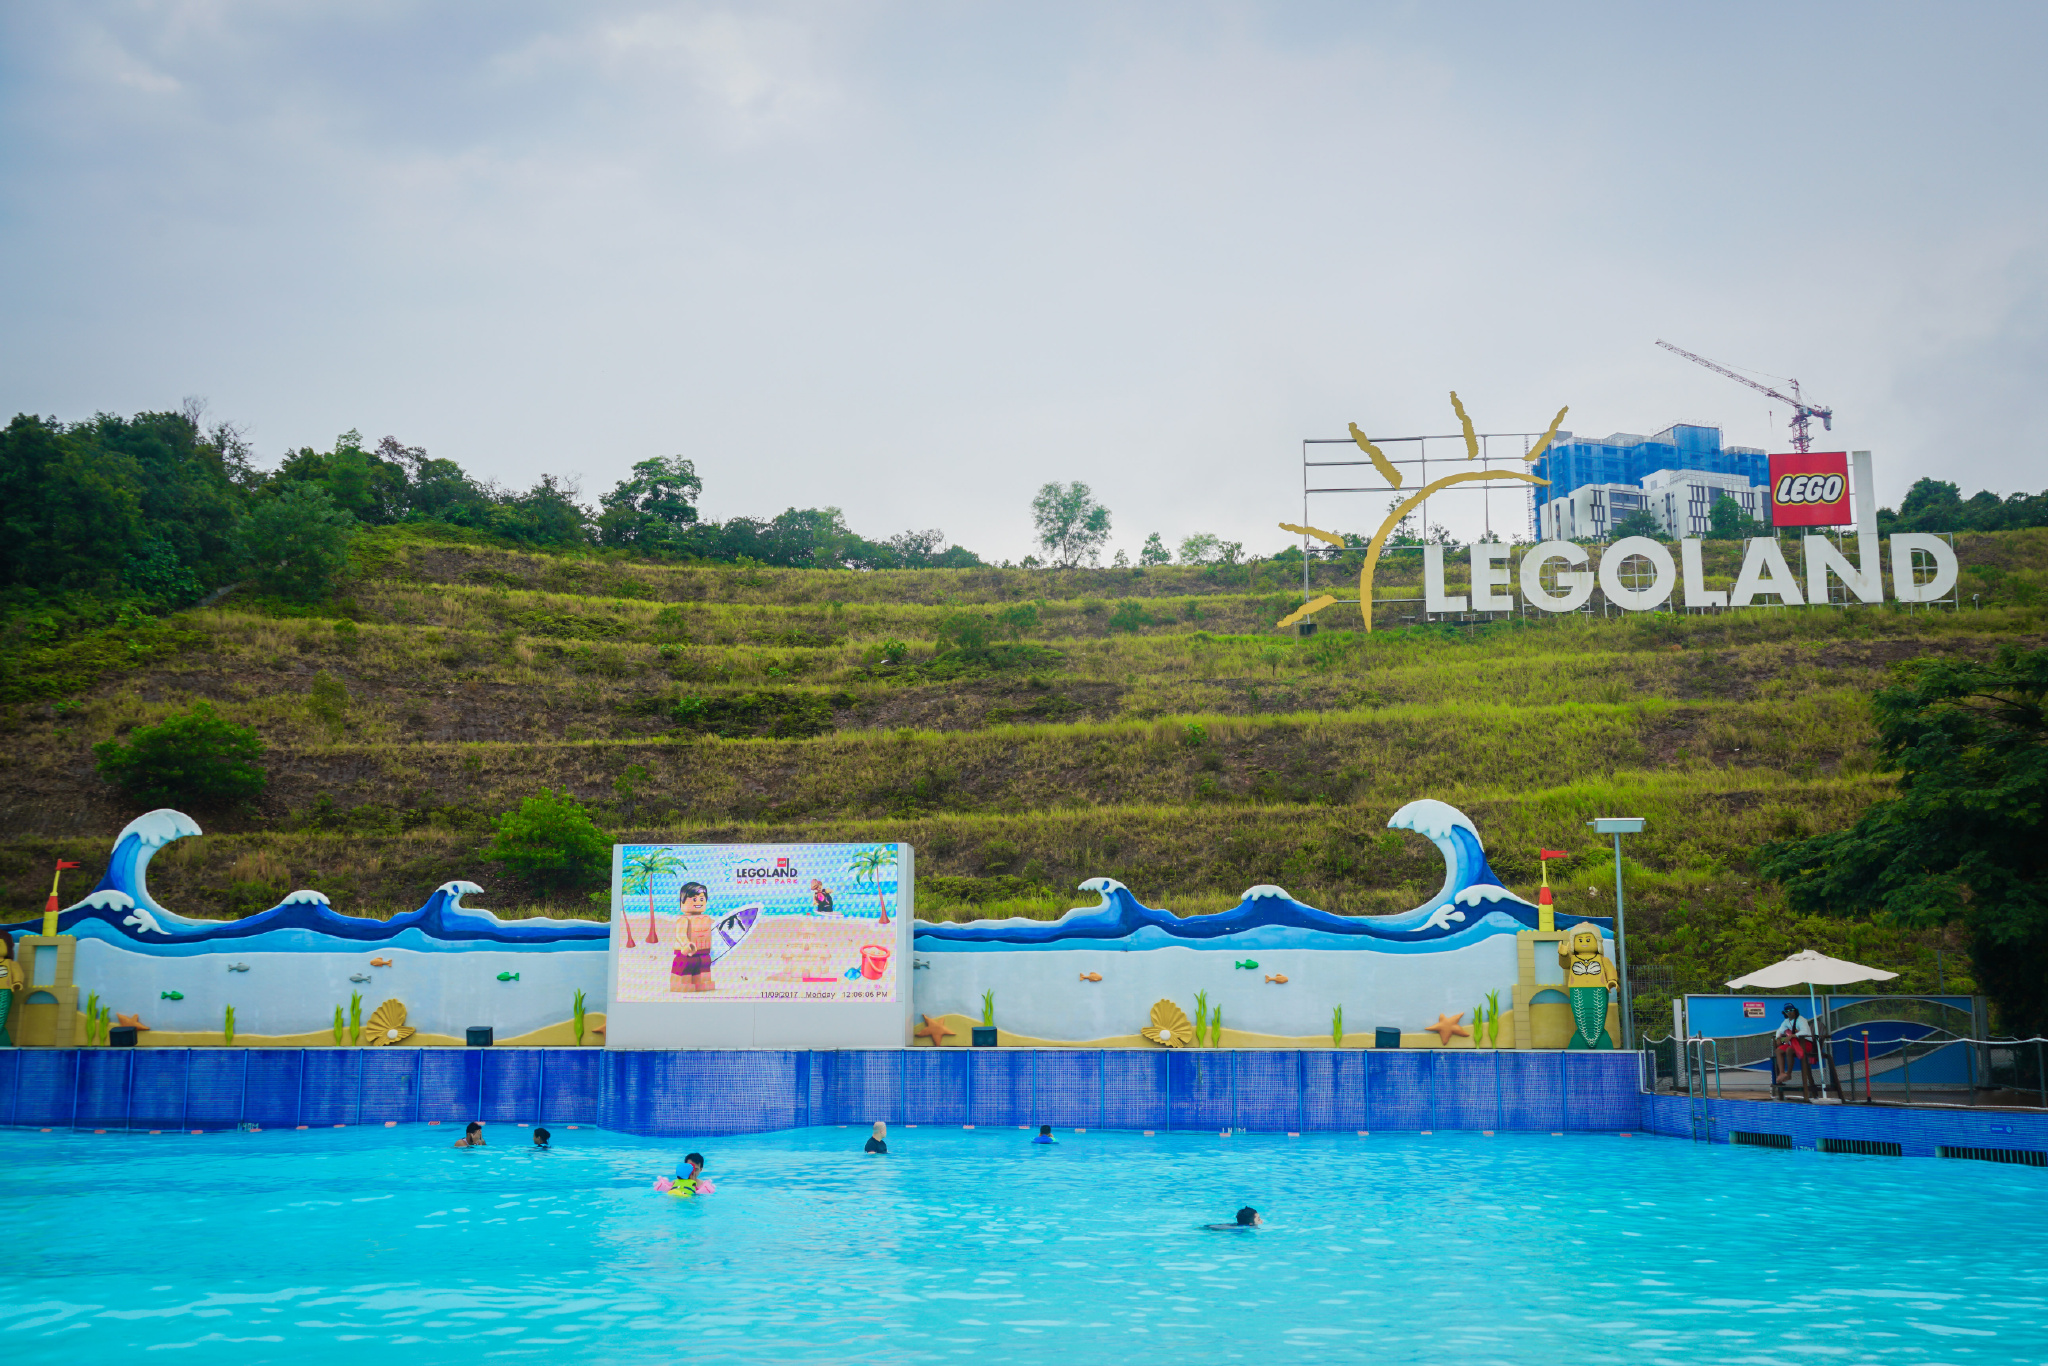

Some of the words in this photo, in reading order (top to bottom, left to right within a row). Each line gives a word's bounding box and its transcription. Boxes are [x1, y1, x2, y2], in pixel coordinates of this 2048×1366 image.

[1774, 473, 1846, 505] LEGO
[1425, 451, 1959, 612] LEGOLAND
[736, 858, 798, 878] LEGOLAND
[760, 991, 798, 999] 11/09/2017
[805, 991, 836, 1000] Monday
[876, 991, 888, 999] PM
